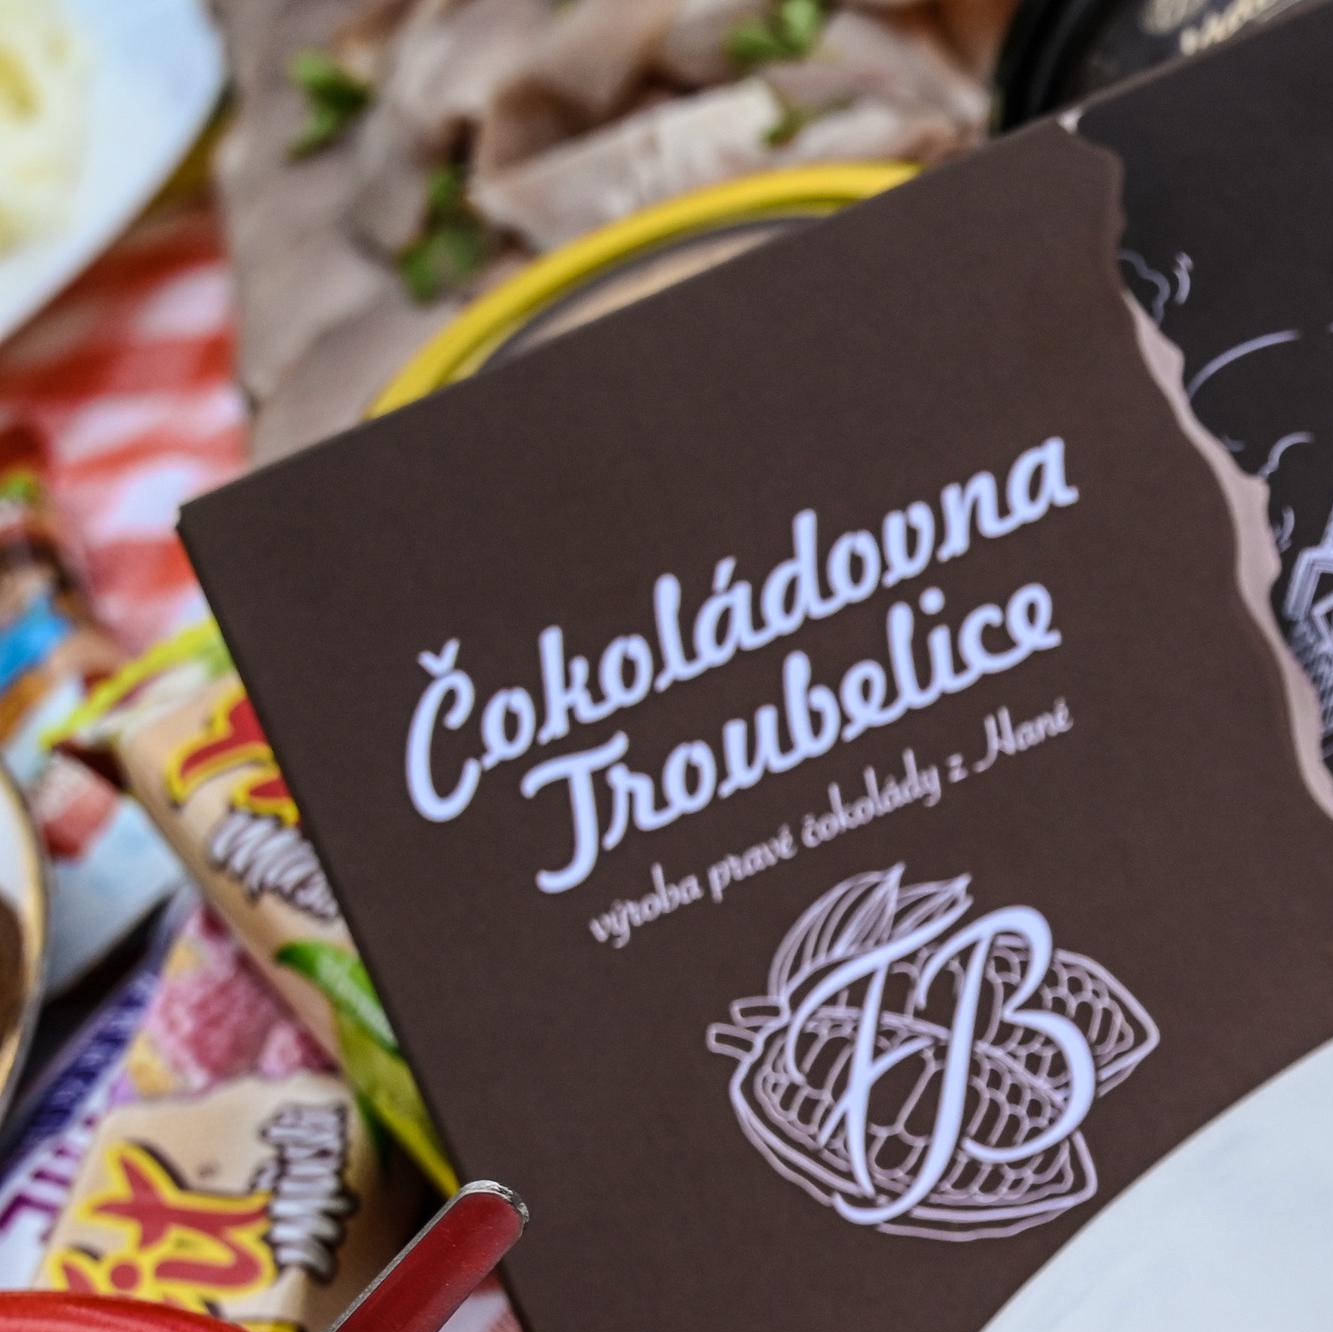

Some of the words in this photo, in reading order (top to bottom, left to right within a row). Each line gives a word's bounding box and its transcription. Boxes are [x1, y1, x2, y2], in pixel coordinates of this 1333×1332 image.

[406, 436, 1079, 822] Čokoládovna
[520, 583, 1061, 894] Troubelice
[589, 862, 703, 949] výroba
[707, 823, 797, 902] pravé
[801, 748, 942, 848] čokolády
[947, 753, 968, 784] z
[974, 698, 1074, 773] Hané
